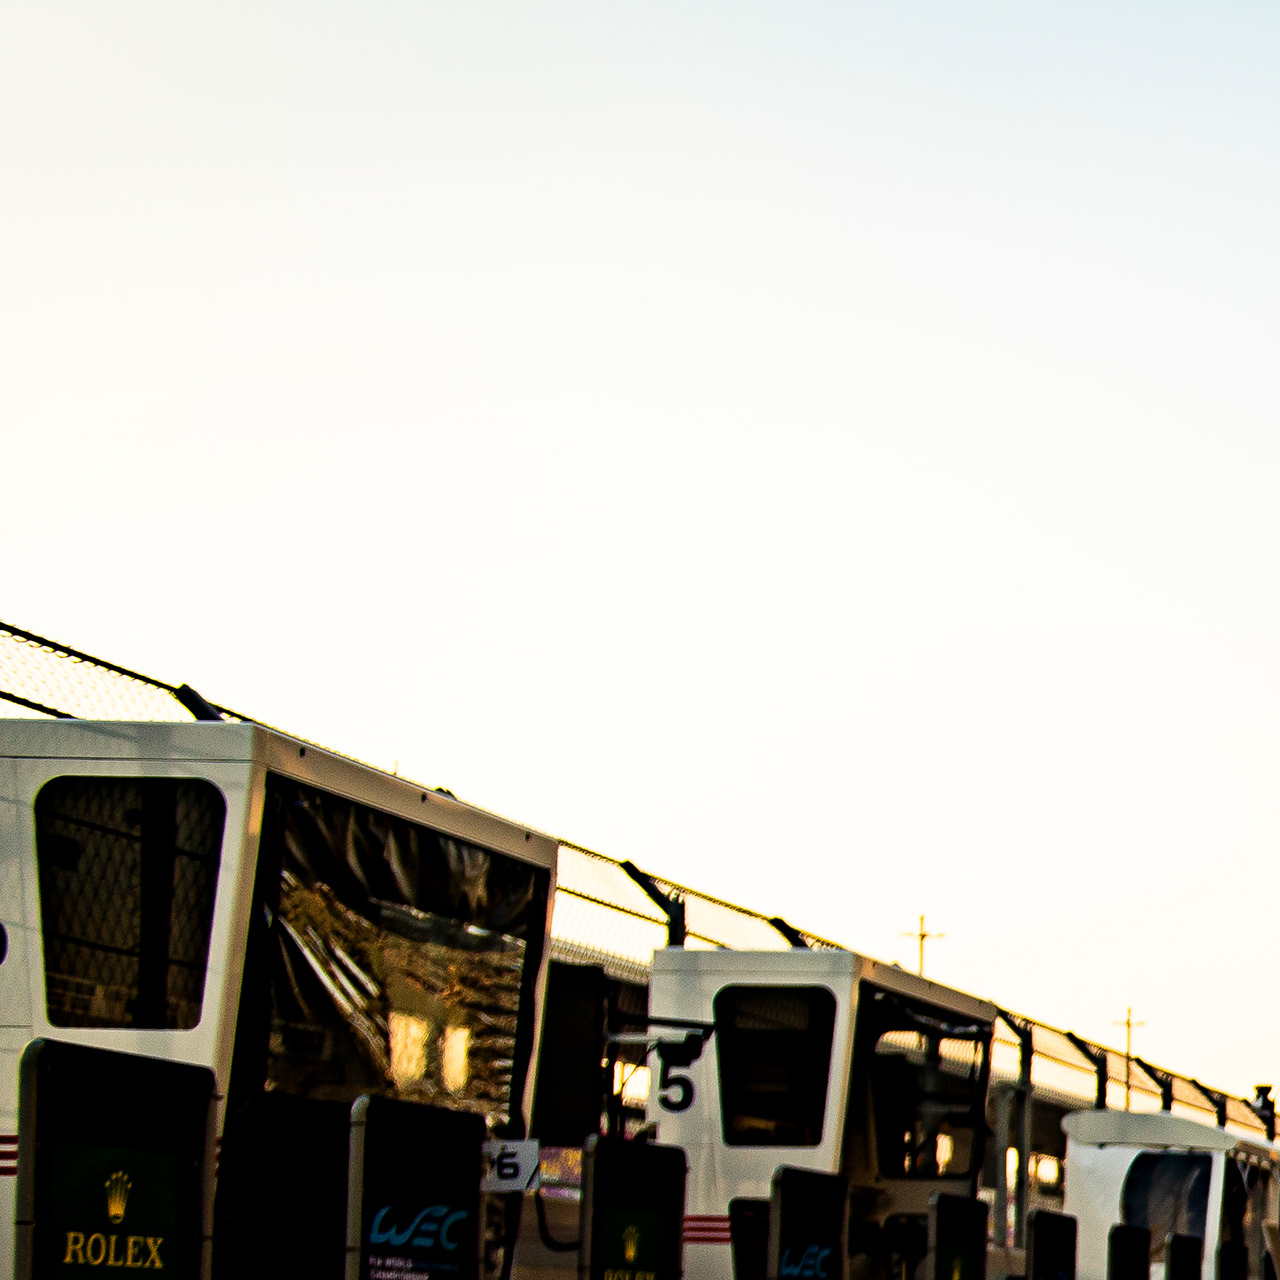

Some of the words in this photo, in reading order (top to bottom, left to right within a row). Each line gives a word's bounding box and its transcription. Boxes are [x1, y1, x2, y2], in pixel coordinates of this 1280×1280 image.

[659, 1057, 694, 1111] 5
[62, 1230, 164, 1270] ROLEX
[369, 1204, 469, 1252] WEC
